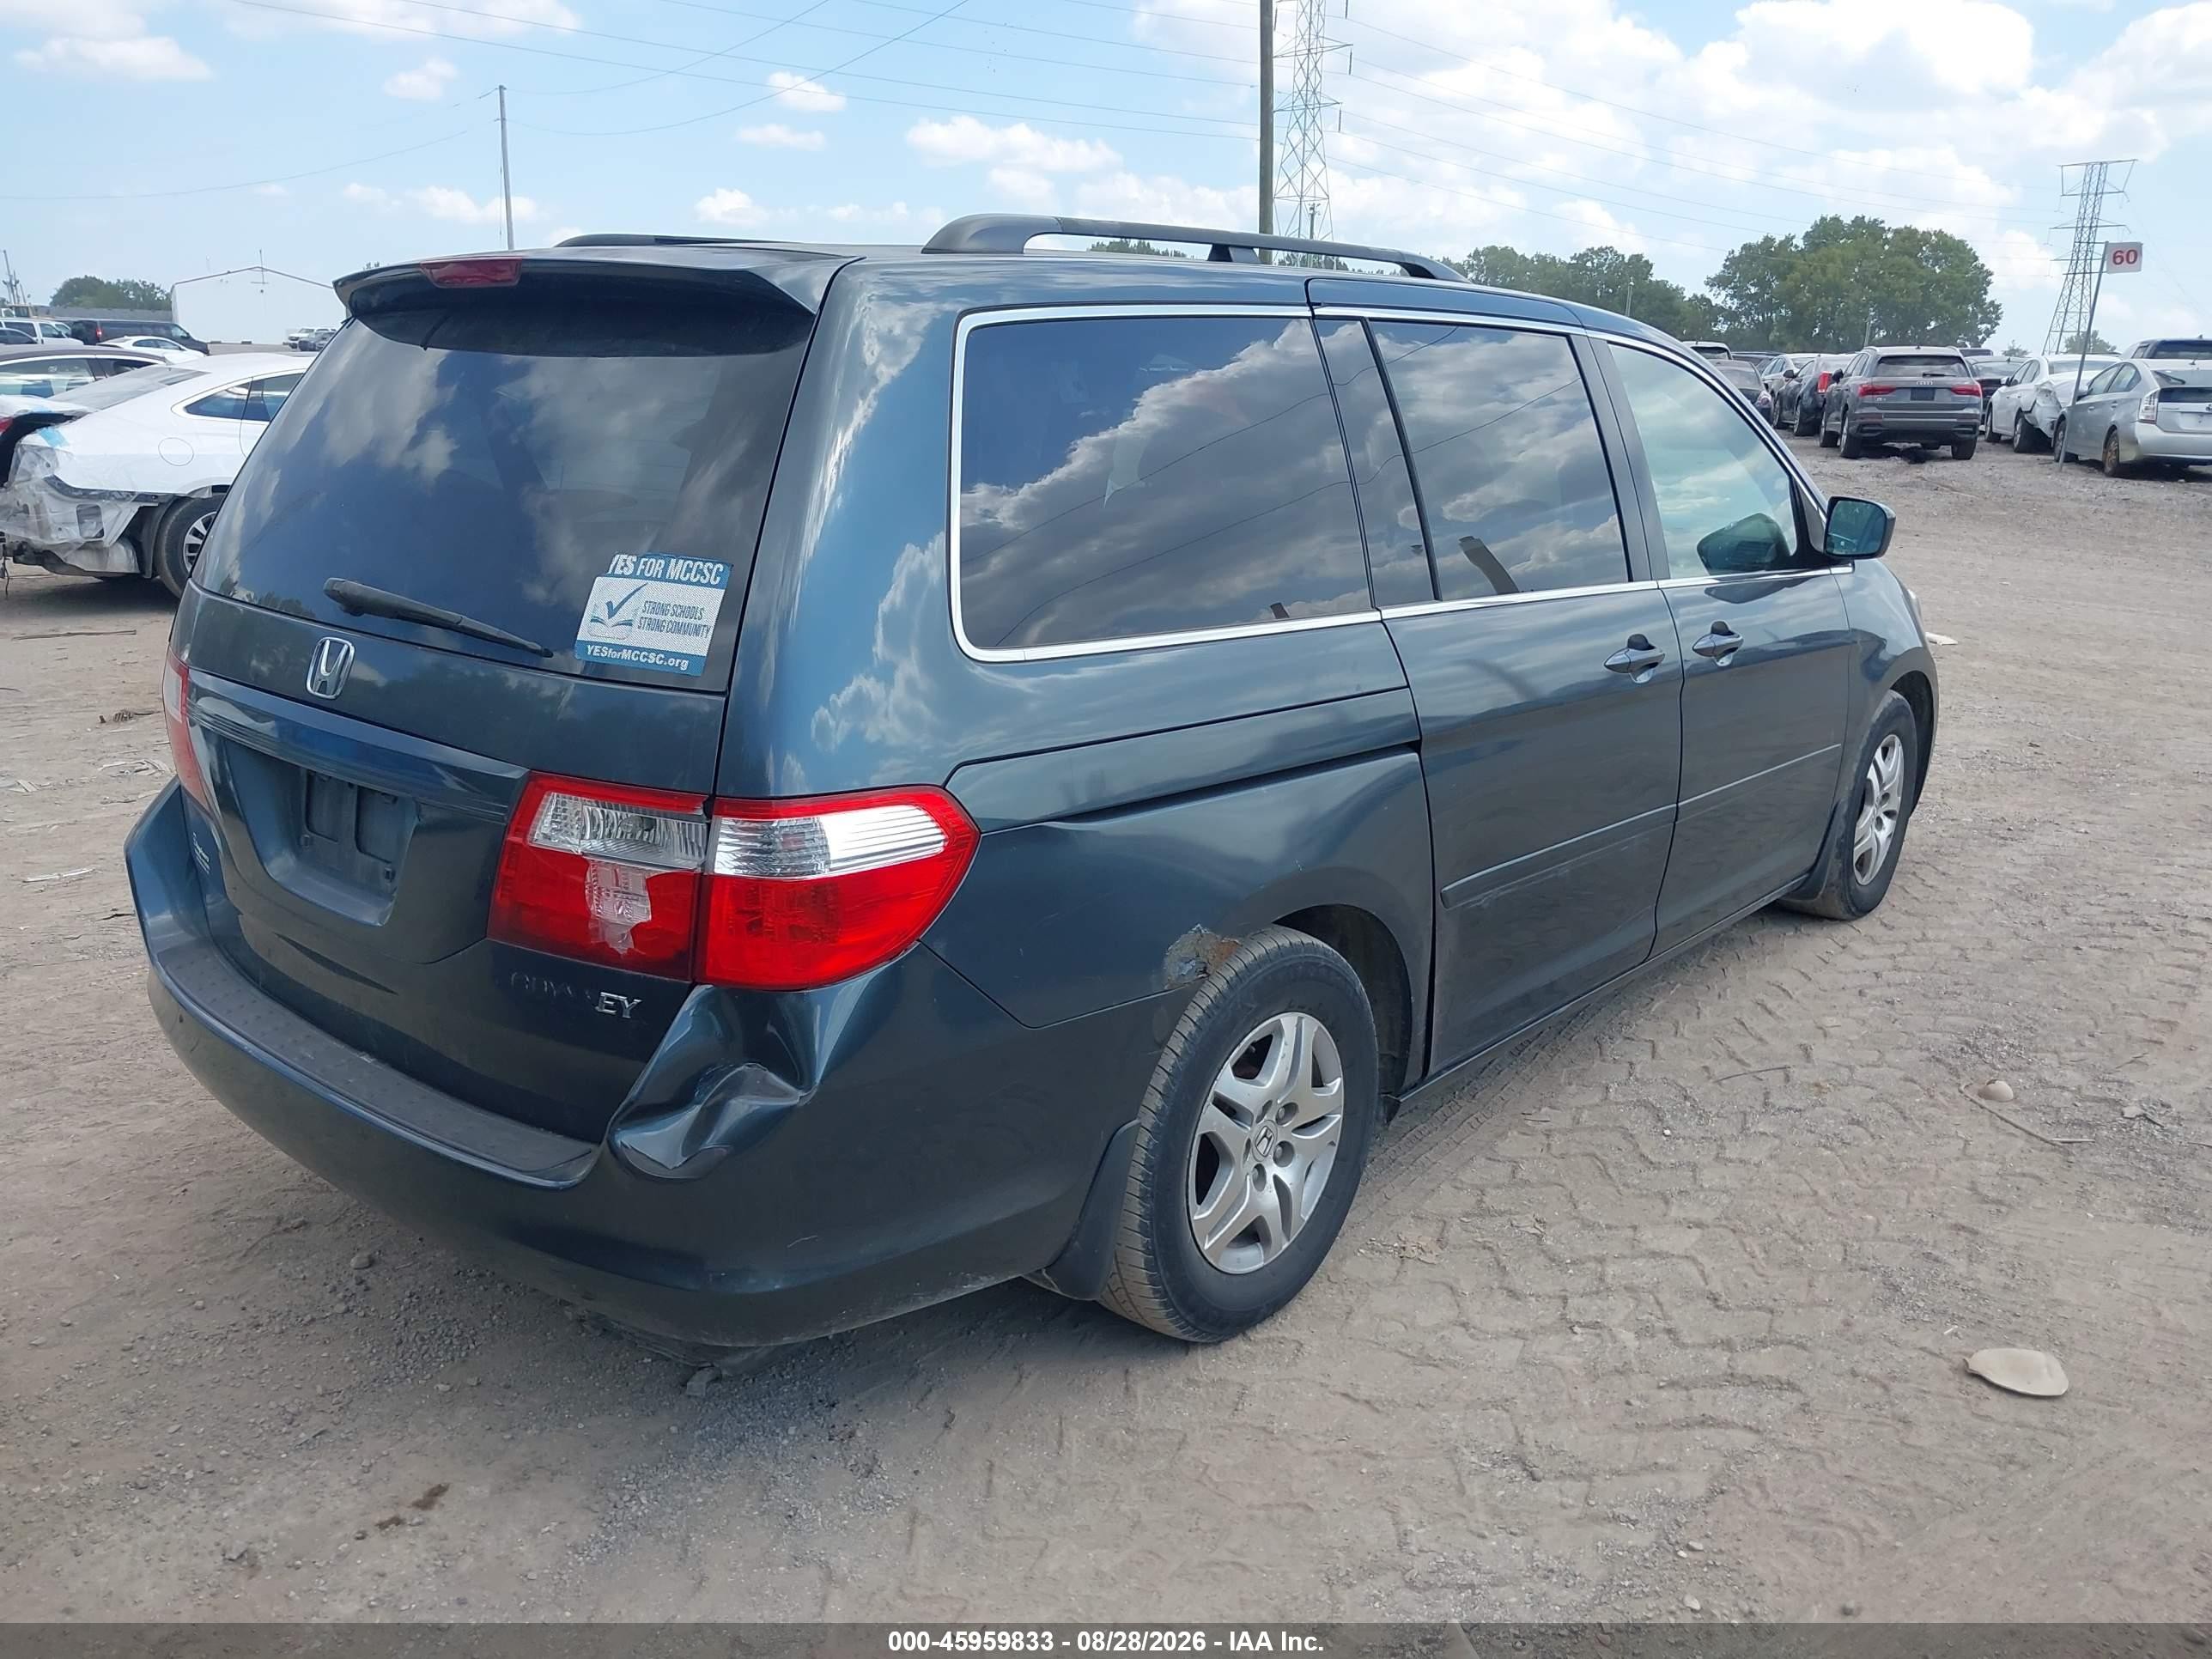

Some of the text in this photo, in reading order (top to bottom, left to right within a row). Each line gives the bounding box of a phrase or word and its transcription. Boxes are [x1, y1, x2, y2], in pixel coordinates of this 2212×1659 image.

[2112, 249, 2138, 265] 60
[606, 554, 724, 586] YES FOR MCCSC
[641, 600, 705, 621] STRONG SCHOOLS
[637, 617, 712, 639] STRONG COMMUNITY
[586, 645, 690, 672] YESforMCCSC.org
